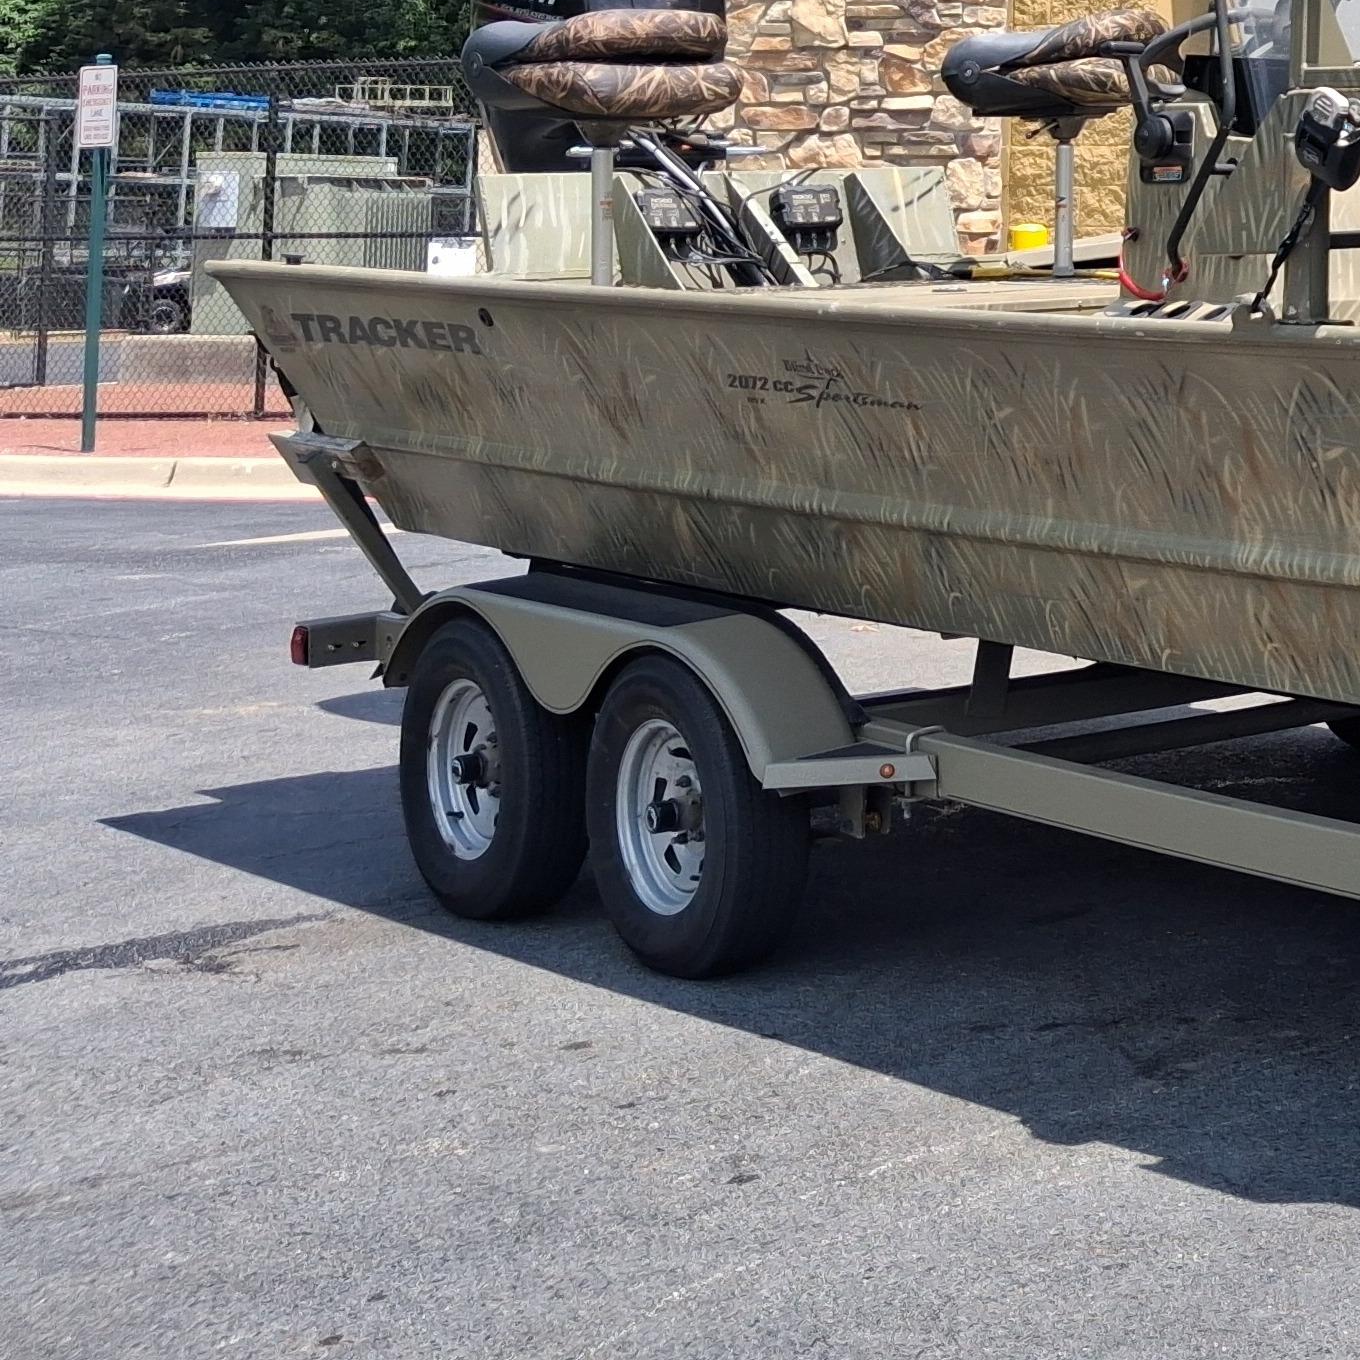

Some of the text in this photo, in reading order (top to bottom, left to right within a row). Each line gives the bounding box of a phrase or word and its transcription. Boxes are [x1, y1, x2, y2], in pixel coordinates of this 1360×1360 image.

[290, 313, 482, 355] TRACKER
[727, 373, 769, 391] 2072
[772, 380, 795, 393] CC
